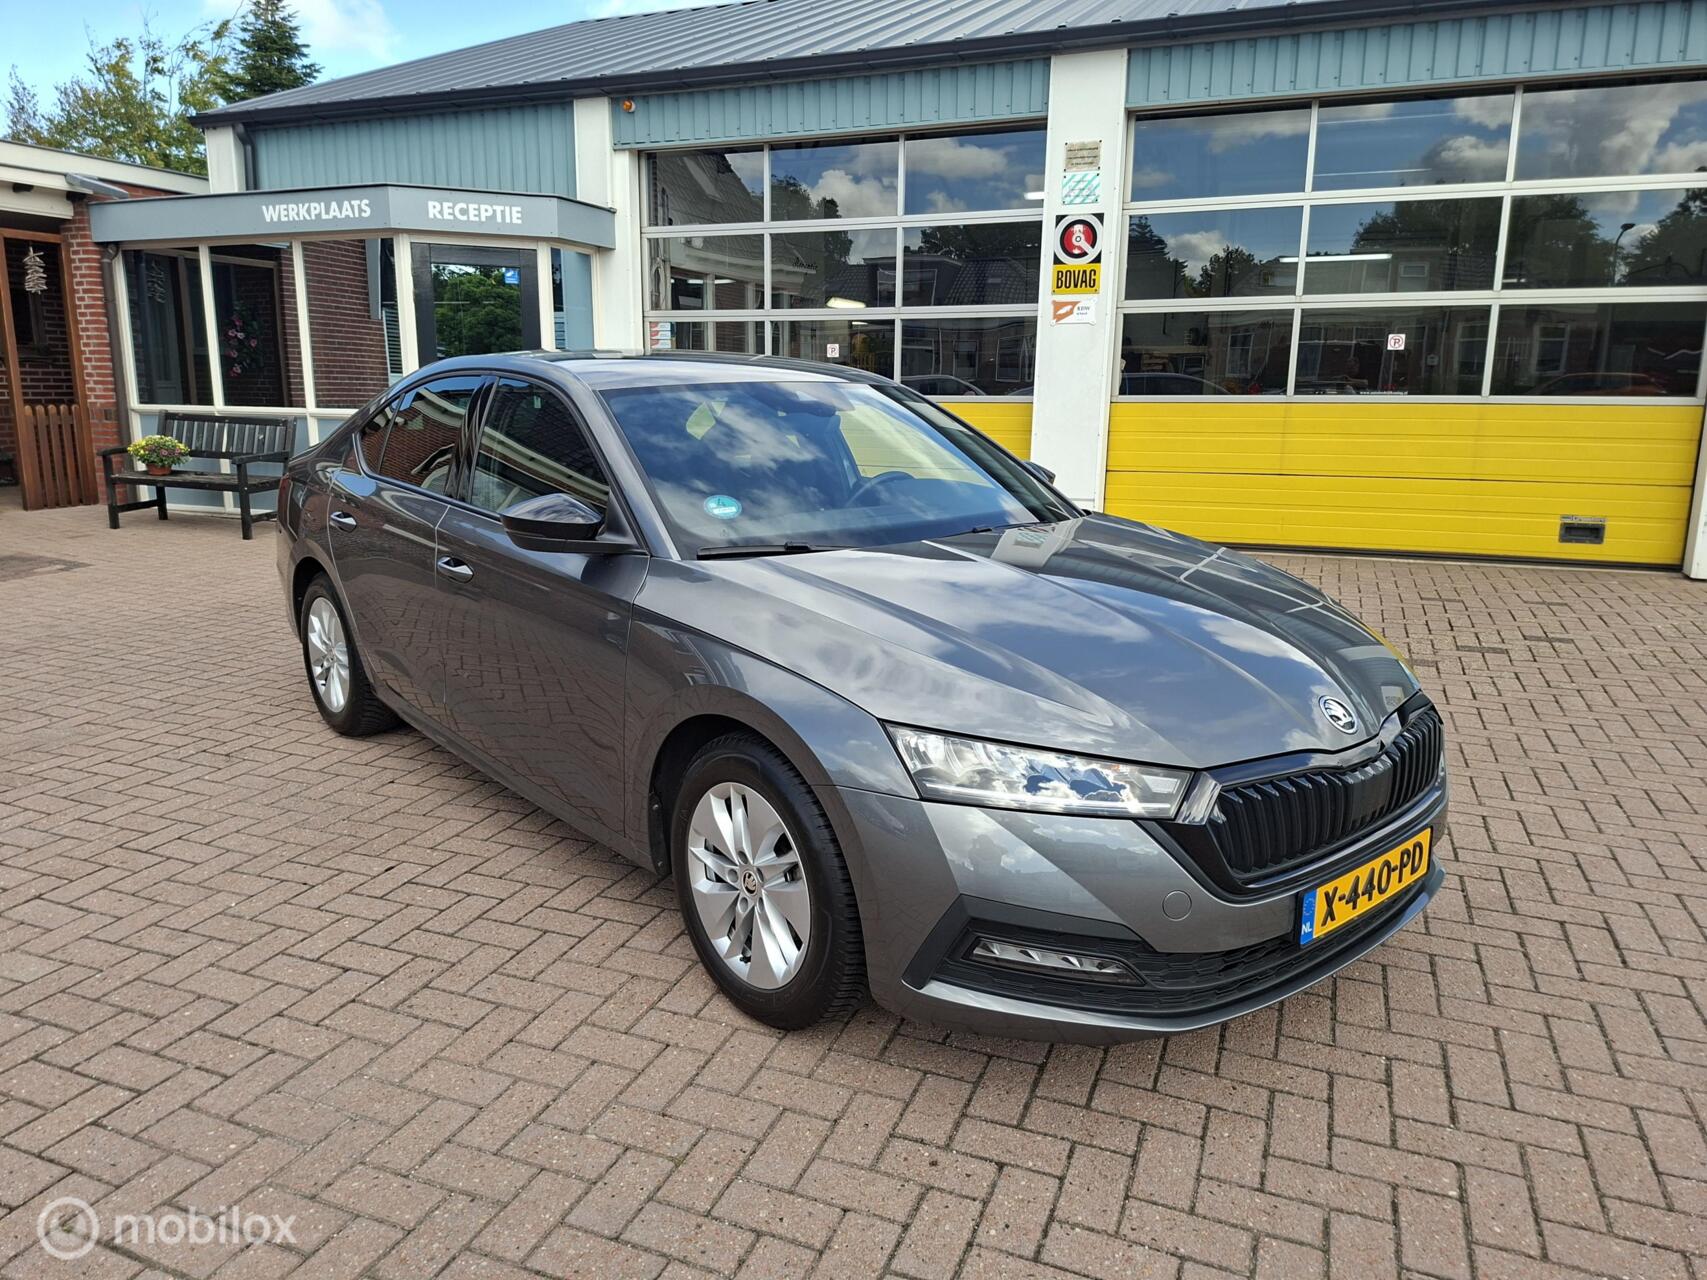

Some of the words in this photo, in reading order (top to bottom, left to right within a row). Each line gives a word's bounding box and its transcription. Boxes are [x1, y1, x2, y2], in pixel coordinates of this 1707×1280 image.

[262, 199, 370, 222] WERKPLAATS
[428, 201, 522, 224] RECEPTIE
[1056, 269, 1097, 289] BOVAG
[1321, 841, 1424, 927] X-440-PD
[1302, 922, 1313, 935] NL
